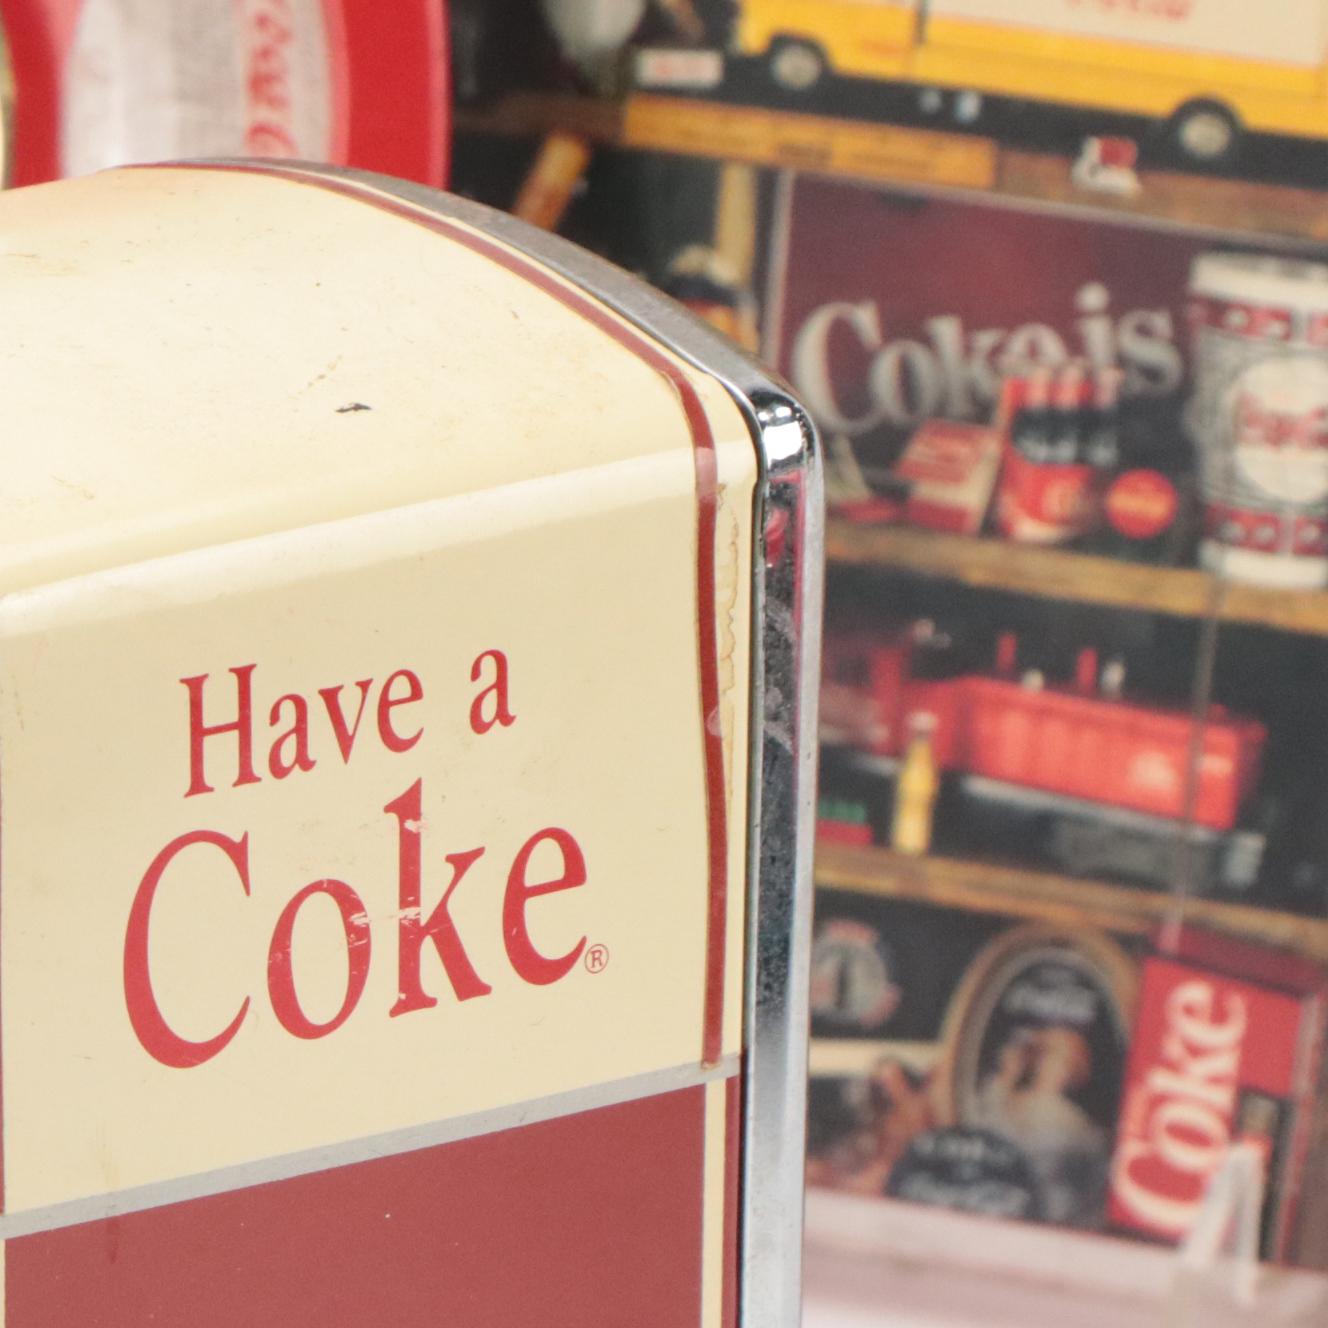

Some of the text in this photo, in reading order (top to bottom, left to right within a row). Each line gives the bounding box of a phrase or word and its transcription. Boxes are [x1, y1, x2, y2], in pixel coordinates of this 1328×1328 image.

[793, 283, 1183, 436] Coke is
[179, 649, 517, 798] Have a
[1114, 982, 1247, 1230] Coke
